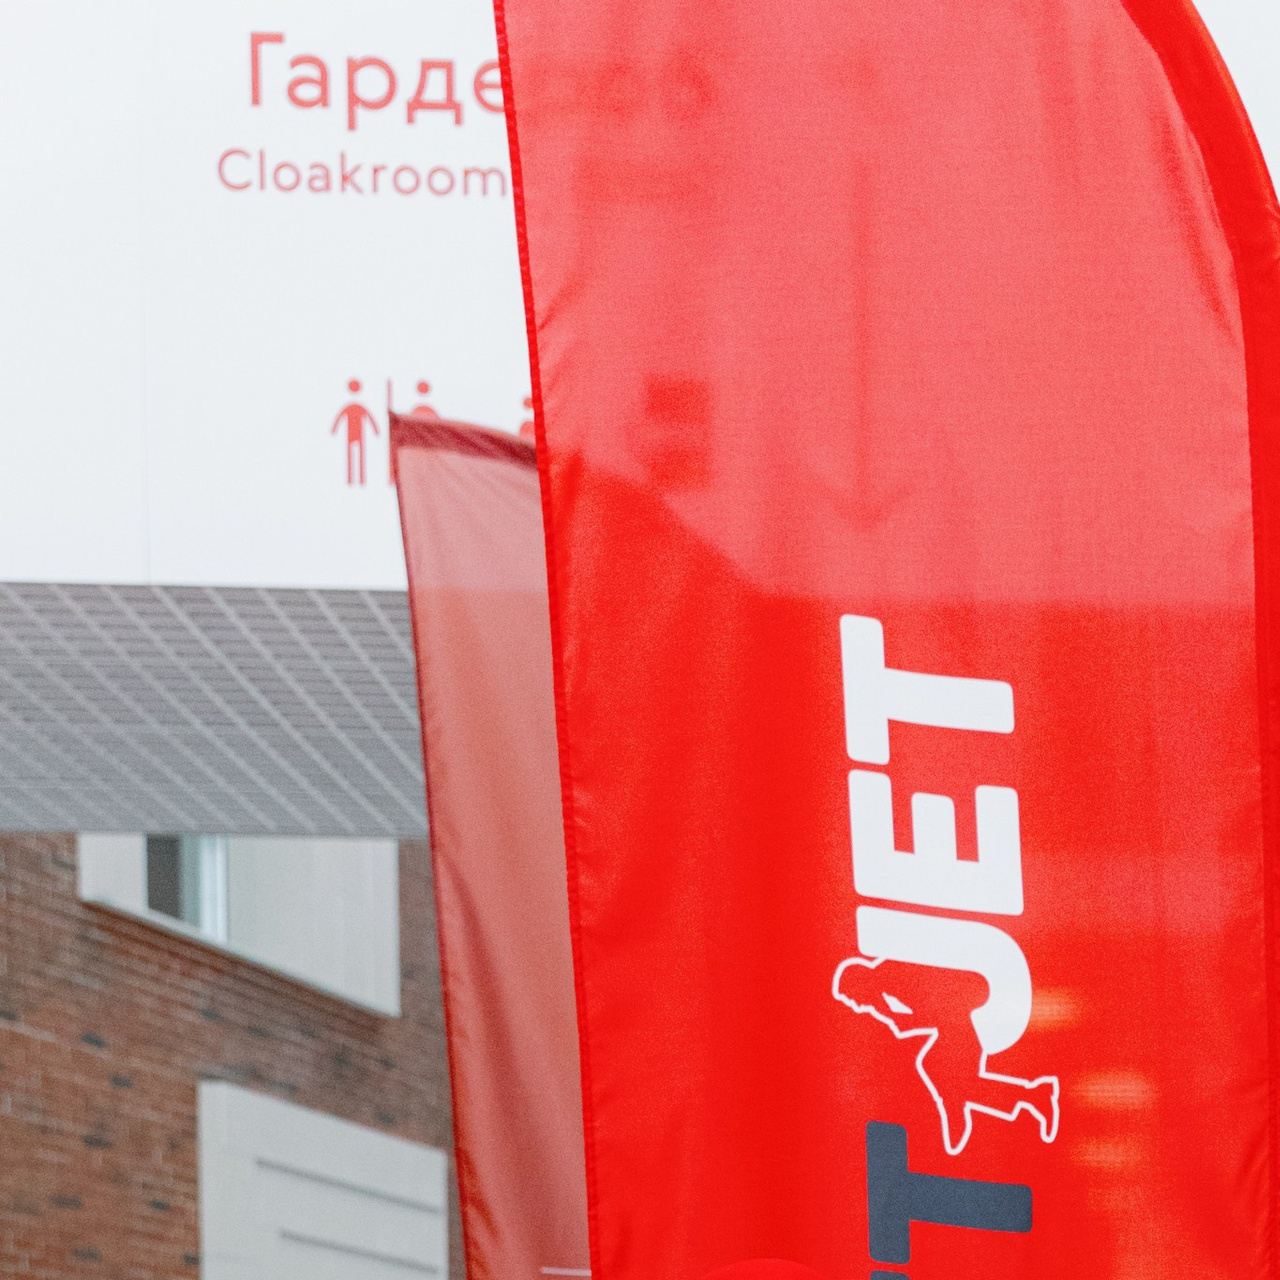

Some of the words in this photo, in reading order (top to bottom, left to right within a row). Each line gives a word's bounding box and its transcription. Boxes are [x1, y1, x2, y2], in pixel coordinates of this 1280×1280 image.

[249, 31, 507, 131] Гарде
[216, 147, 508, 197] Cloakroom
[839, 613, 1033, 1056] JET
